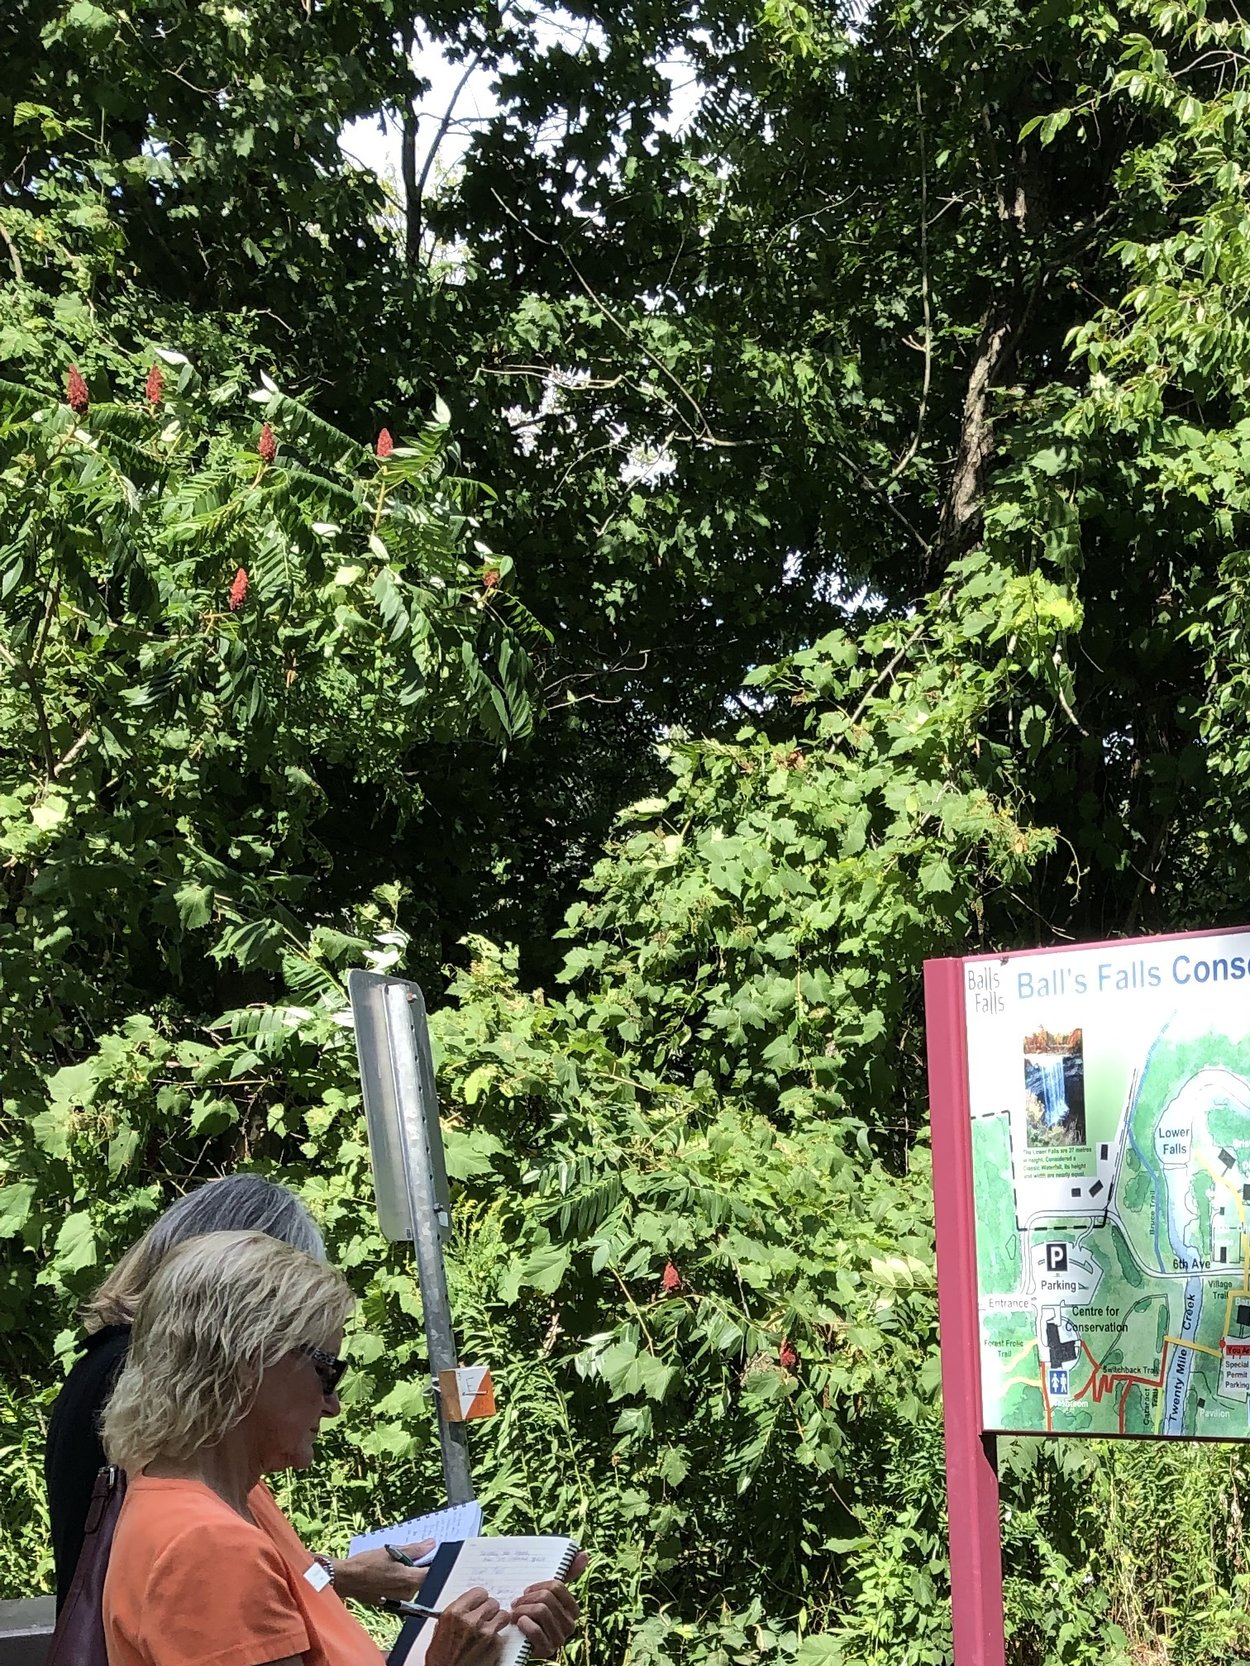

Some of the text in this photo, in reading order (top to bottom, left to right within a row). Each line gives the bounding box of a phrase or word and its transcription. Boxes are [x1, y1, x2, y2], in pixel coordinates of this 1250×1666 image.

[968, 967, 1000, 991] Balls
[1017, 967, 1088, 999] Ball's
[1098, 960, 1162, 992] Falls
[975, 991, 1005, 1014] Falls
[1158, 1126, 1190, 1139] Lower
[1162, 1143, 1187, 1156] Falls
[1173, 1258, 1211, 1269] 6th Ave
[1041, 1280, 1077, 1293] Parking
[1208, 1280, 1233, 1290] Village
[1213, 1291, 1229, 1299] Trail
[988, 1298, 1029, 1309] Entrance
[1071, 1305, 1119, 1317] Centre for
[1065, 1322, 1129, 1333] Conservation
[984, 1339, 1024, 1347] Forest Frolic
[998, 1350, 1011, 1358] Trail
[1228, 1346, 1240, 1354] You
[1169, 1293, 1196, 1421] Twenty Mile Creek
[1103, 1365, 1141, 1374] Switchback
[1225, 1361, 1249, 1369] Special
[1226, 1370, 1248, 1378] Permit
[1225, 1381, 1249, 1390] Parking
[1200, 1408, 1231, 1418] Pavilion
